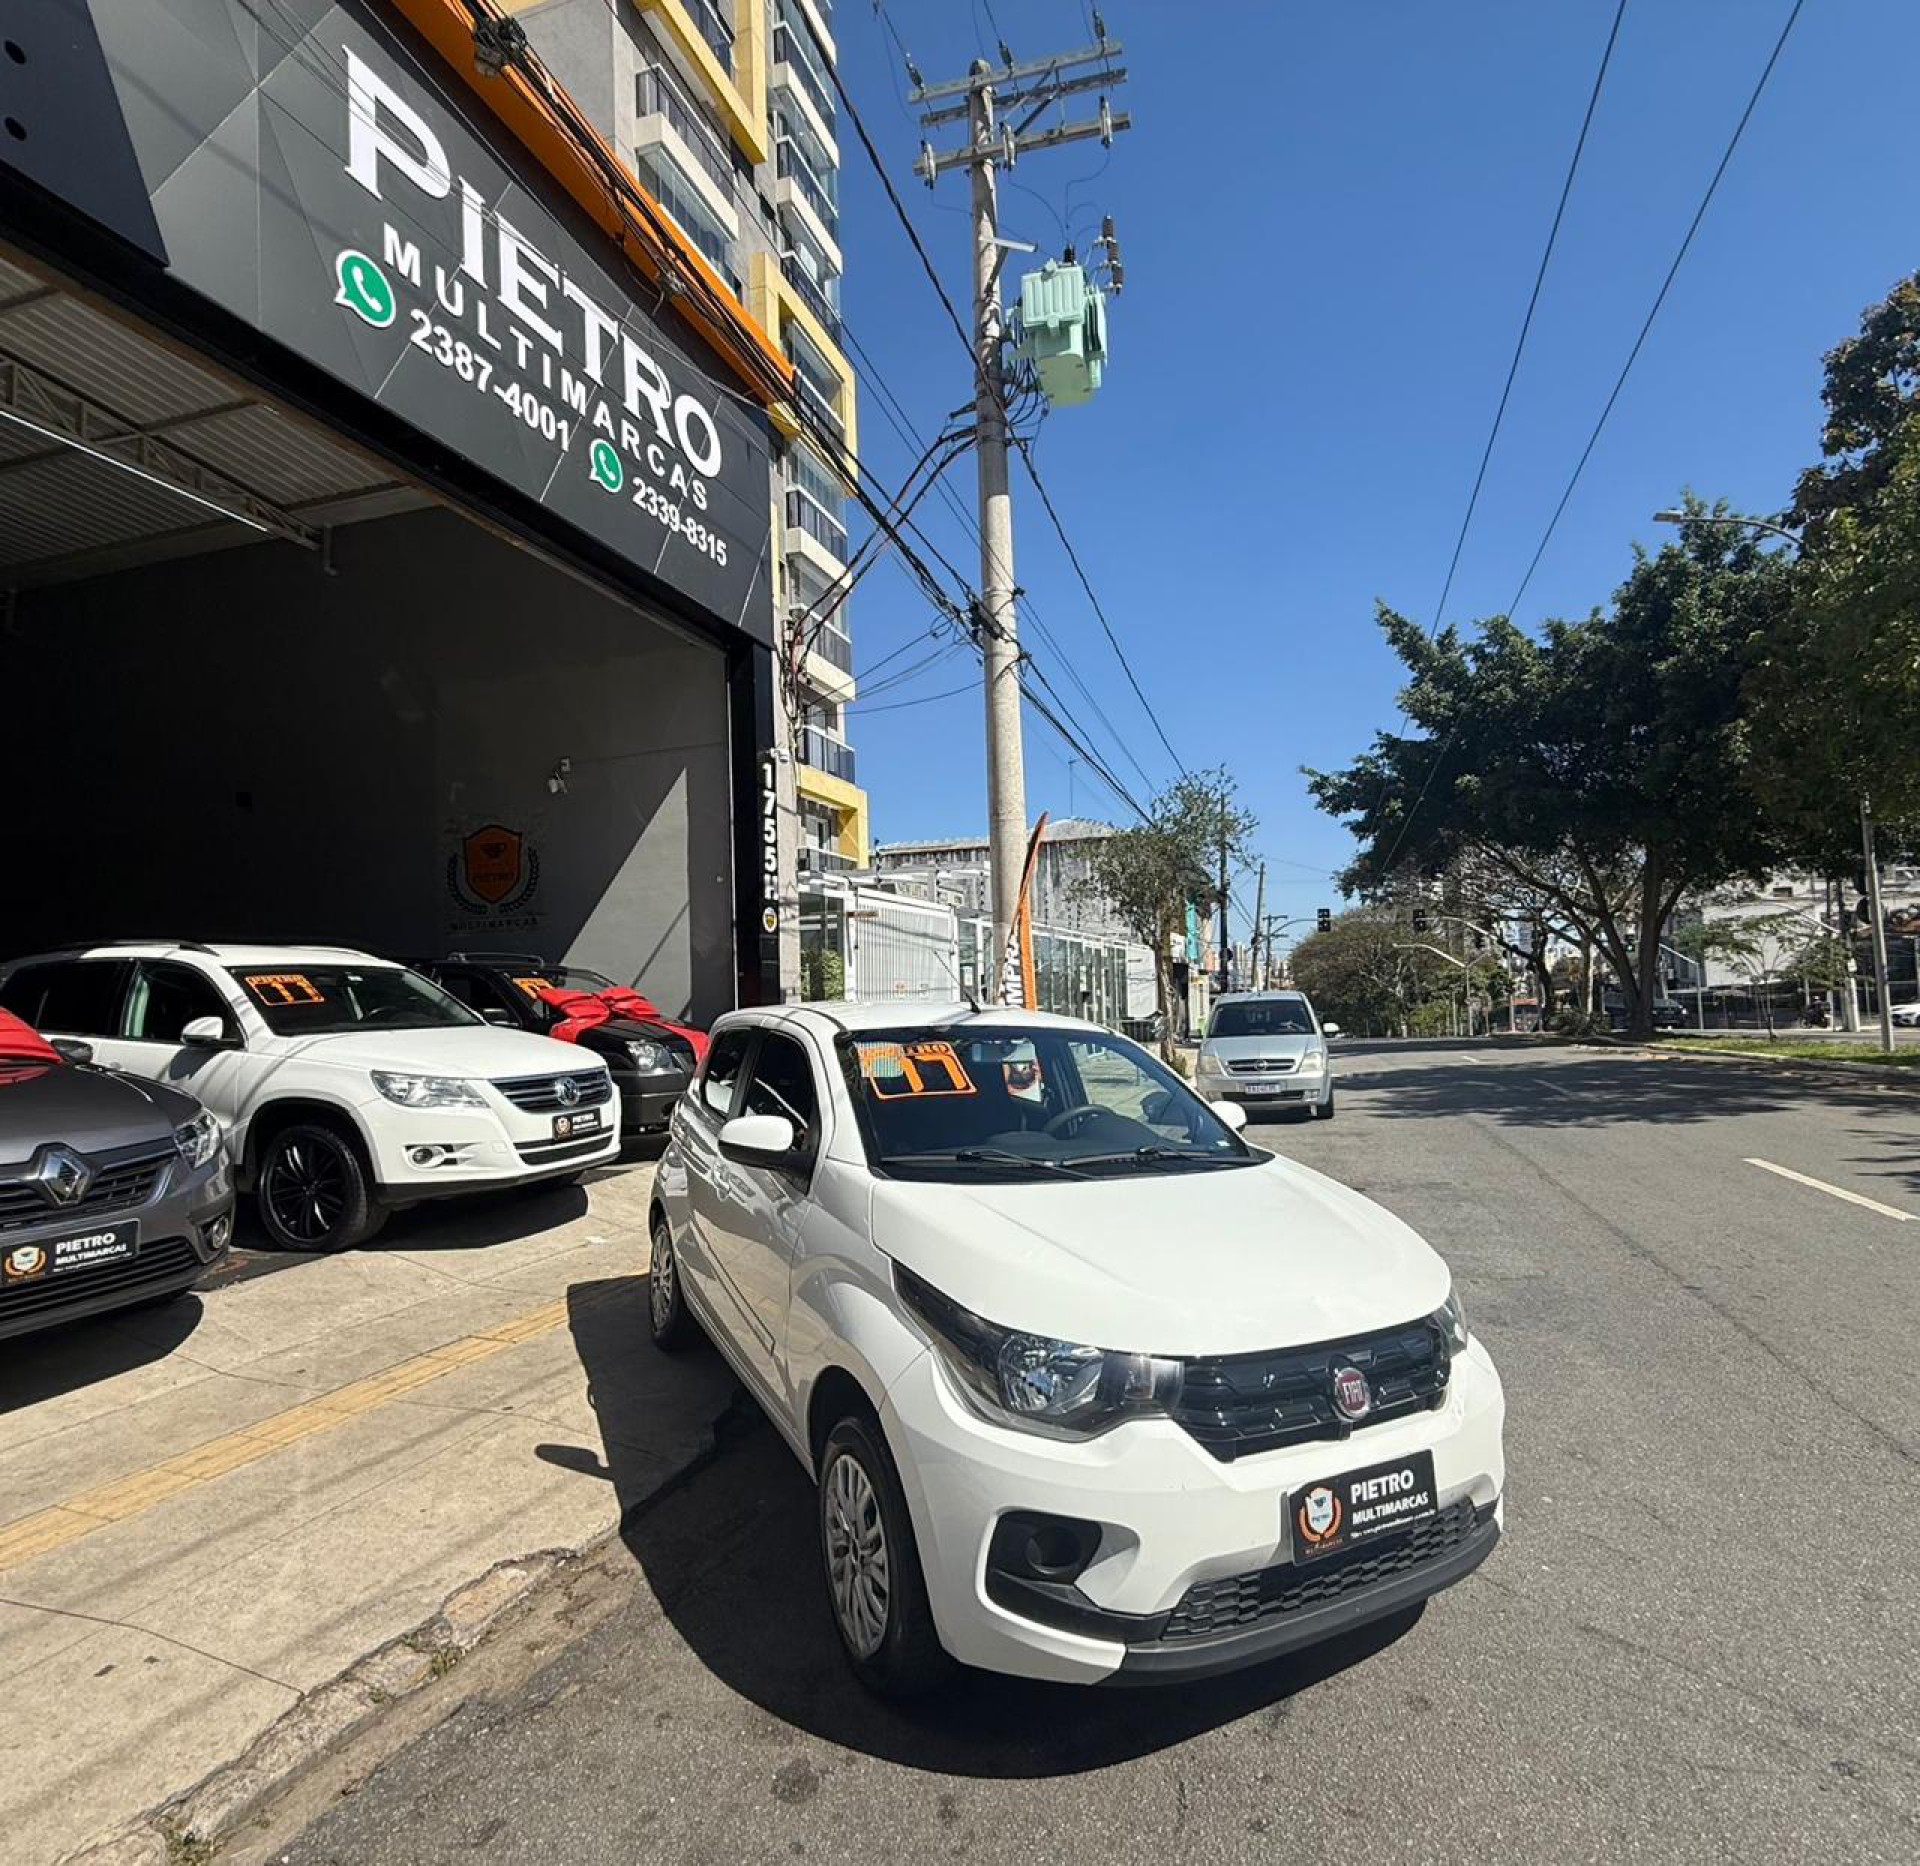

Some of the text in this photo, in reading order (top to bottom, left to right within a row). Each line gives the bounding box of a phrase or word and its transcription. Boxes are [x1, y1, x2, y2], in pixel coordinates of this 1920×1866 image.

[342, 45, 722, 478] PIETRO
[384, 221, 708, 511] MULTIMARCAS
[410, 309, 571, 452] 2387-4001
[632, 477, 728, 567] 2339-8315
[55, 1243, 127, 1266] MULTIMARCAS
[56, 1232, 117, 1255] PIETRO
[1350, 1469, 1414, 1504] PIETRO
[1352, 1490, 1429, 1525] MULTIMARCAS
